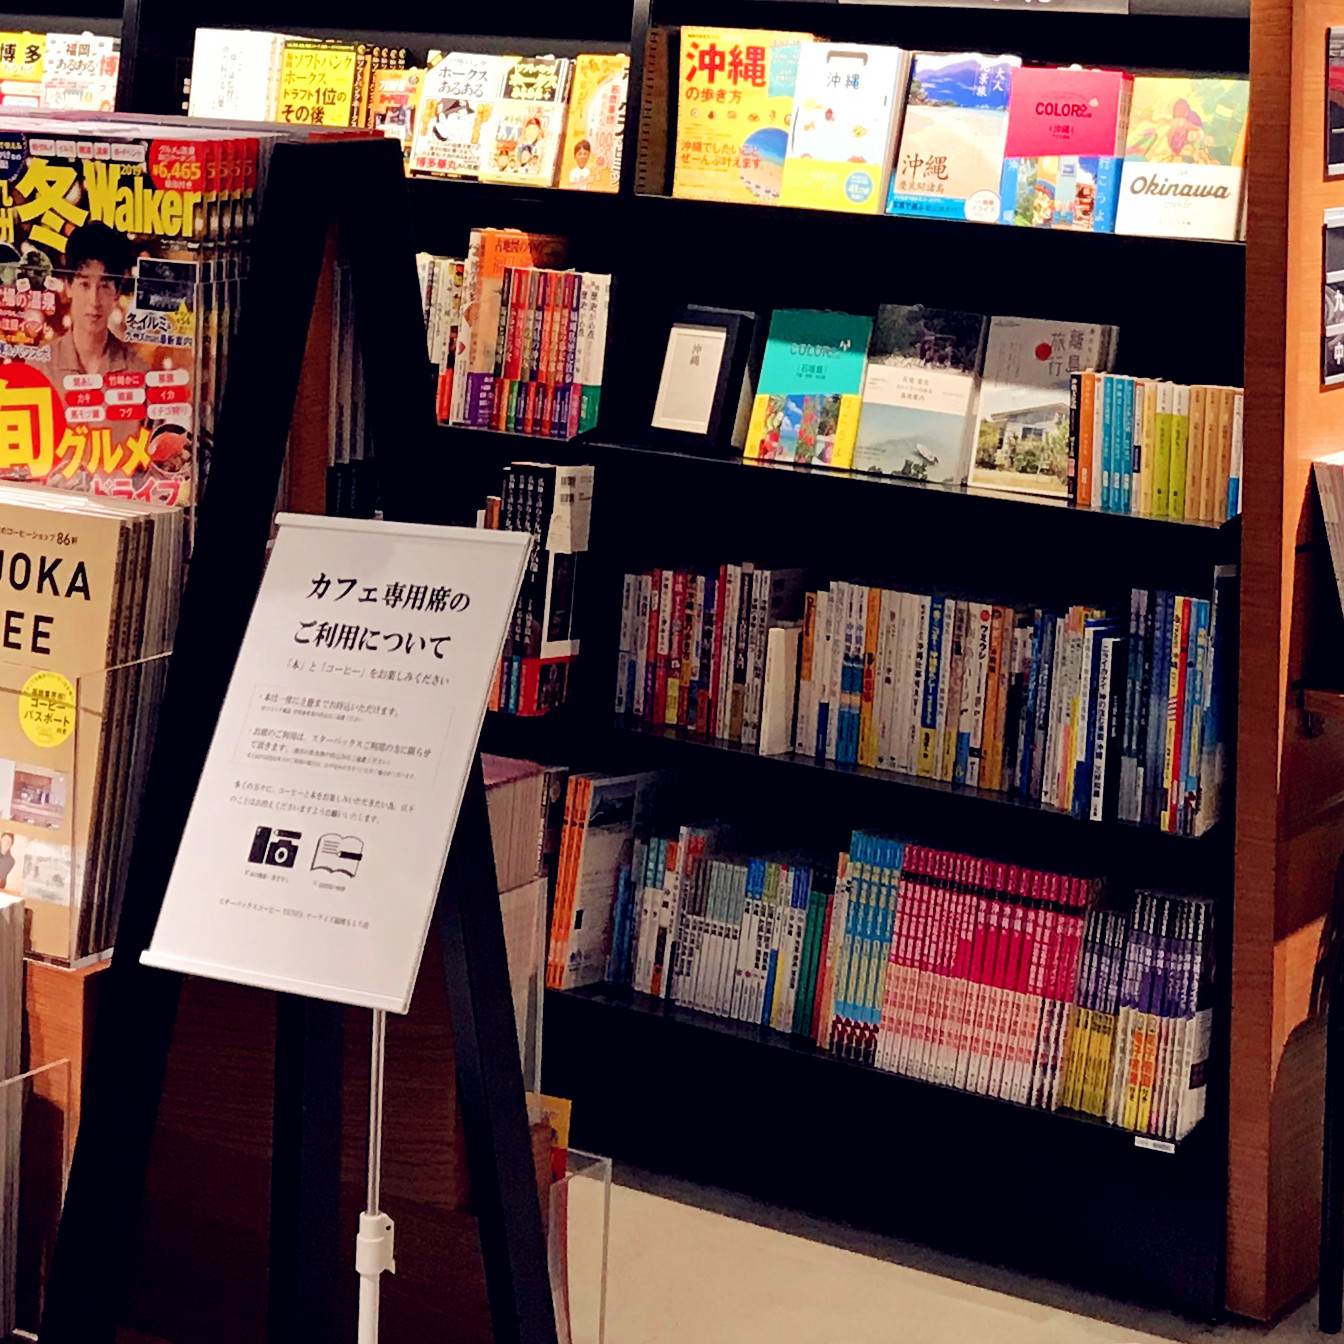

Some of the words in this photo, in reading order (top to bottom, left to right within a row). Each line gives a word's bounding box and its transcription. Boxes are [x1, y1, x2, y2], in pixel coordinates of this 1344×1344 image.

[0, 43, 42, 63] 博多
[65, 43, 90, 57] 福岡
[56, 58, 95, 73] あるある
[293, 53, 352, 72] ソフトバンク
[685, 41, 766, 87] 沖縄
[284, 72, 327, 84] ホークス
[438, 67, 488, 81] ホークス
[827, 72, 860, 89] 沖縄
[993, 67, 1005, 92] 大人
[283, 86, 347, 105] ドラフト1位の
[438, 81, 484, 97] あるある
[685, 87, 742, 105] の歩き方
[280, 106, 325, 124] その後
[681, 140, 760, 156] 沖縄でしたいこと
[119, 164, 141, 175] 2019
[902, 153, 948, 181] 沖縄
[1128, 172, 1232, 202] Okinawa
[1048, 332, 1065, 377] 旅行
[56, 426, 151, 479] グルメ
[91, 477, 183, 506] ドライブ
[305, 571, 471, 614] カフェ専用席の
[292, 618, 452, 660] ご利用について
[31, 698, 66, 712] コーヒー
[23, 710, 70, 728] パスポート
